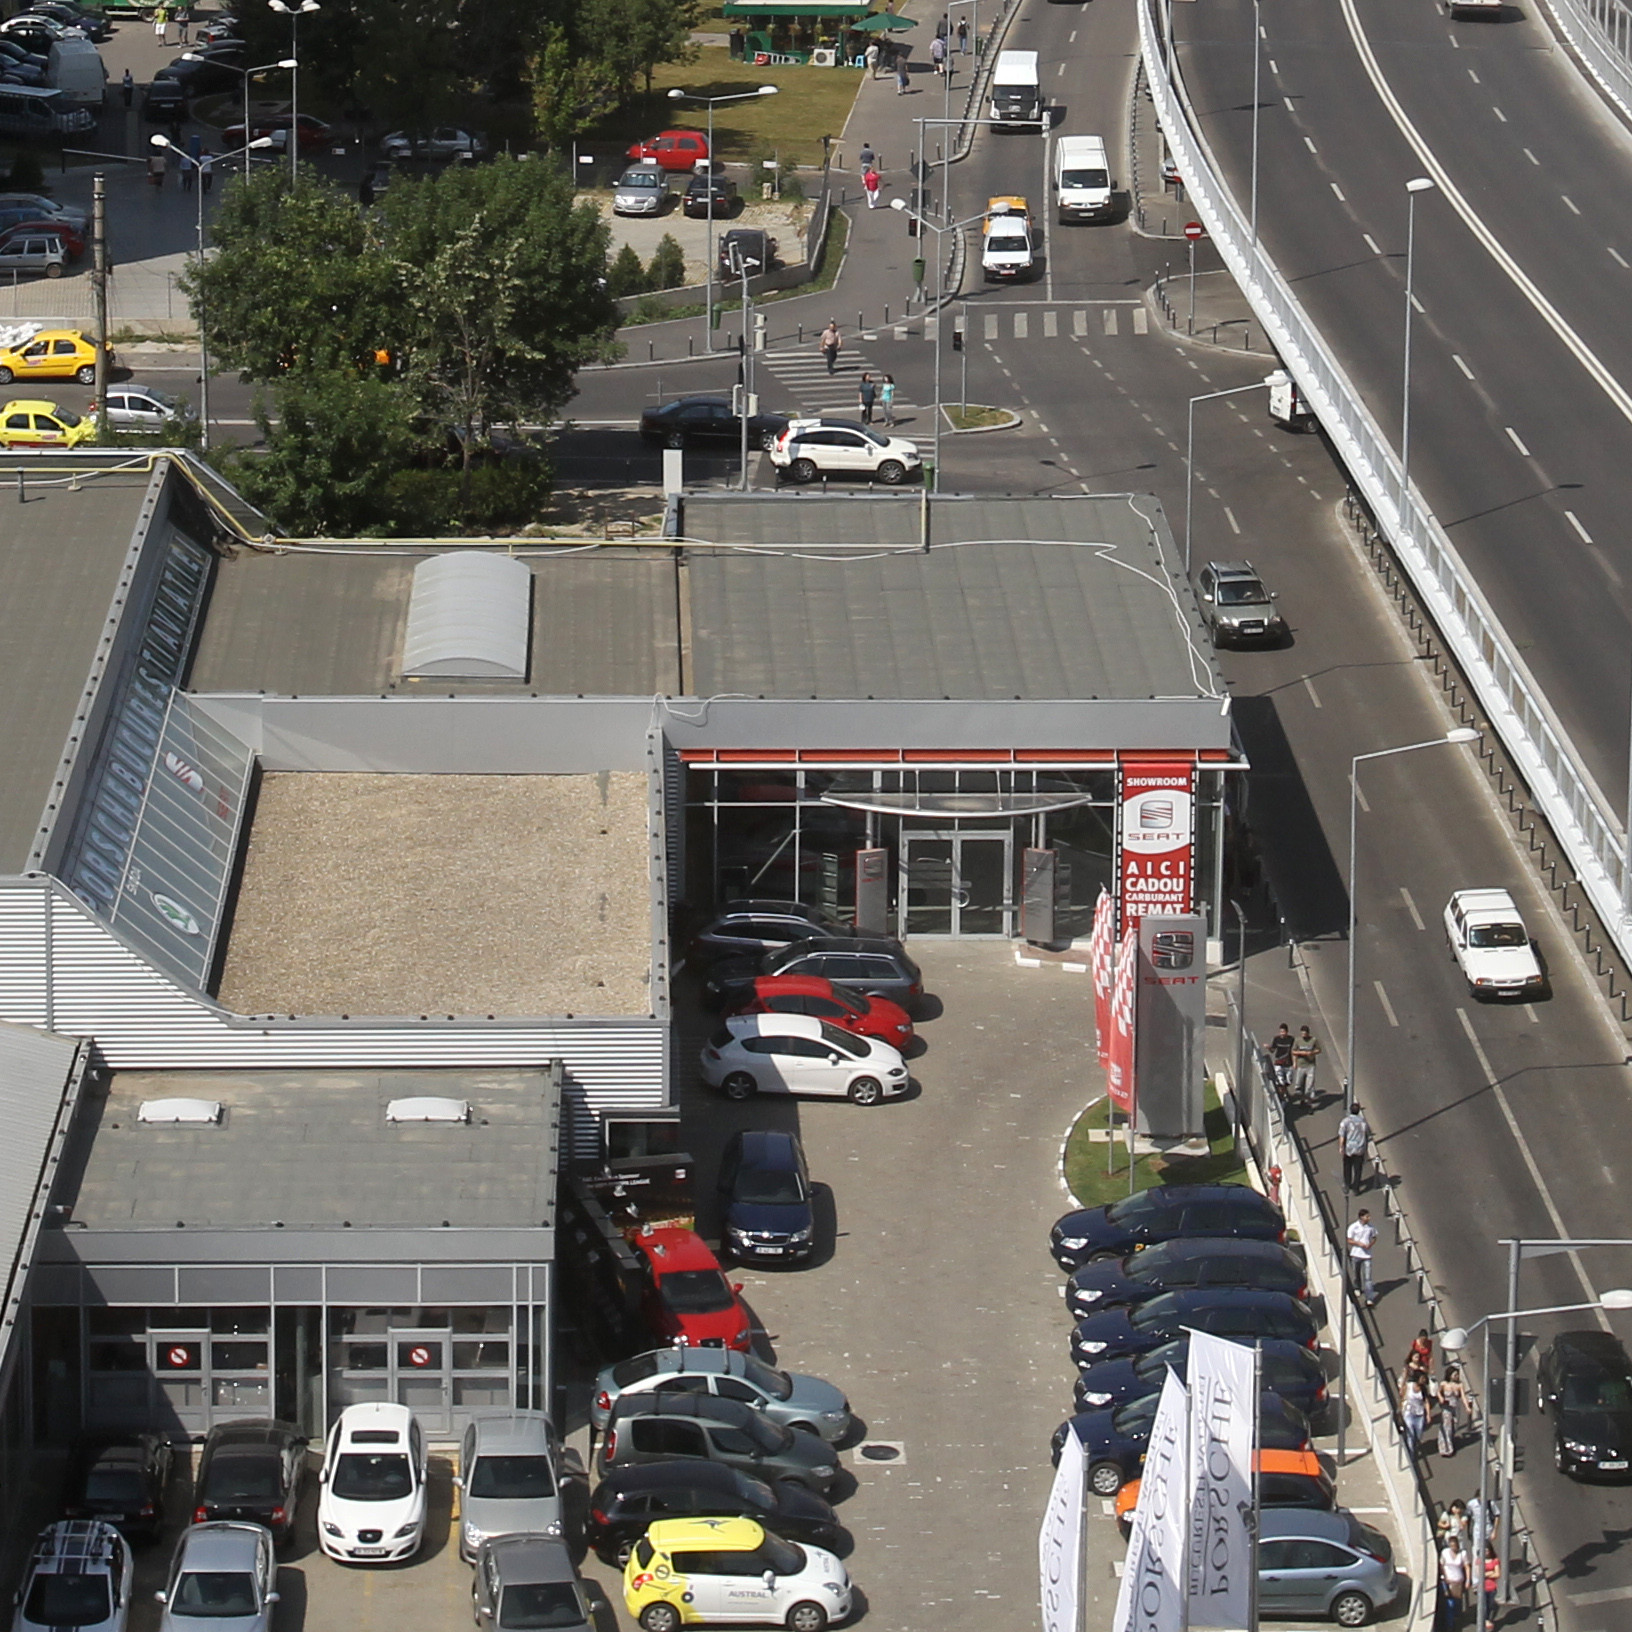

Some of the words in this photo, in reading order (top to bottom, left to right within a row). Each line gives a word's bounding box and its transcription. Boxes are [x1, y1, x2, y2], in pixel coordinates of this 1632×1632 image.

[1126, 777, 1187, 786] SHOWROOM
[1128, 832, 1185, 841] SEAT
[1125, 877, 1184, 892] CADOU
[1125, 892, 1184, 902] CARBURANT
[1126, 903, 1184, 916] REMAT
[1144, 976, 1200, 985] SEAT
[728, 1590, 767, 1599] AUSTRAL
